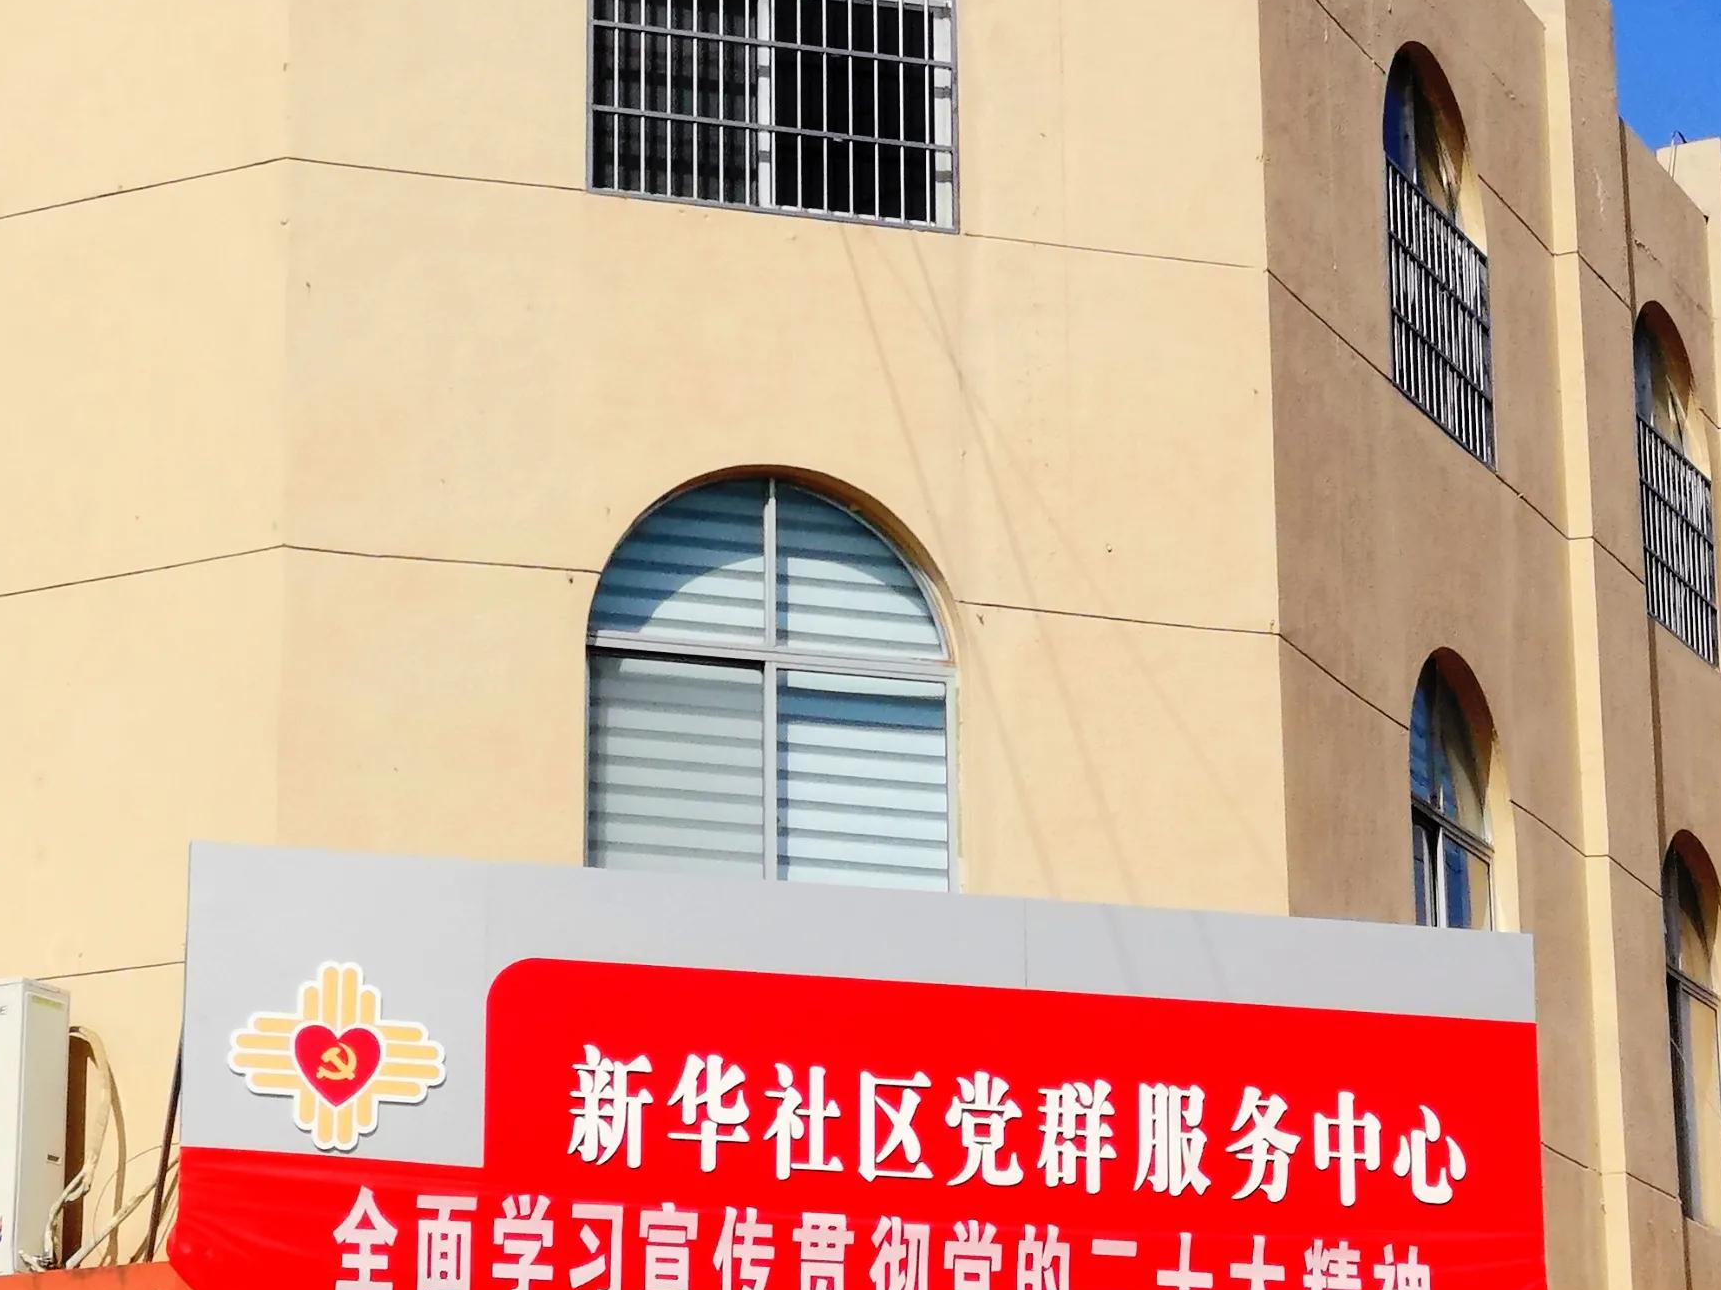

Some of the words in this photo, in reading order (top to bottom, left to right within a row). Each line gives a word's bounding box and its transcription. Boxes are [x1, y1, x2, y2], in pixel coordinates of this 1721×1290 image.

[568, 1044, 1468, 1207] 新华社区党群服务中心
